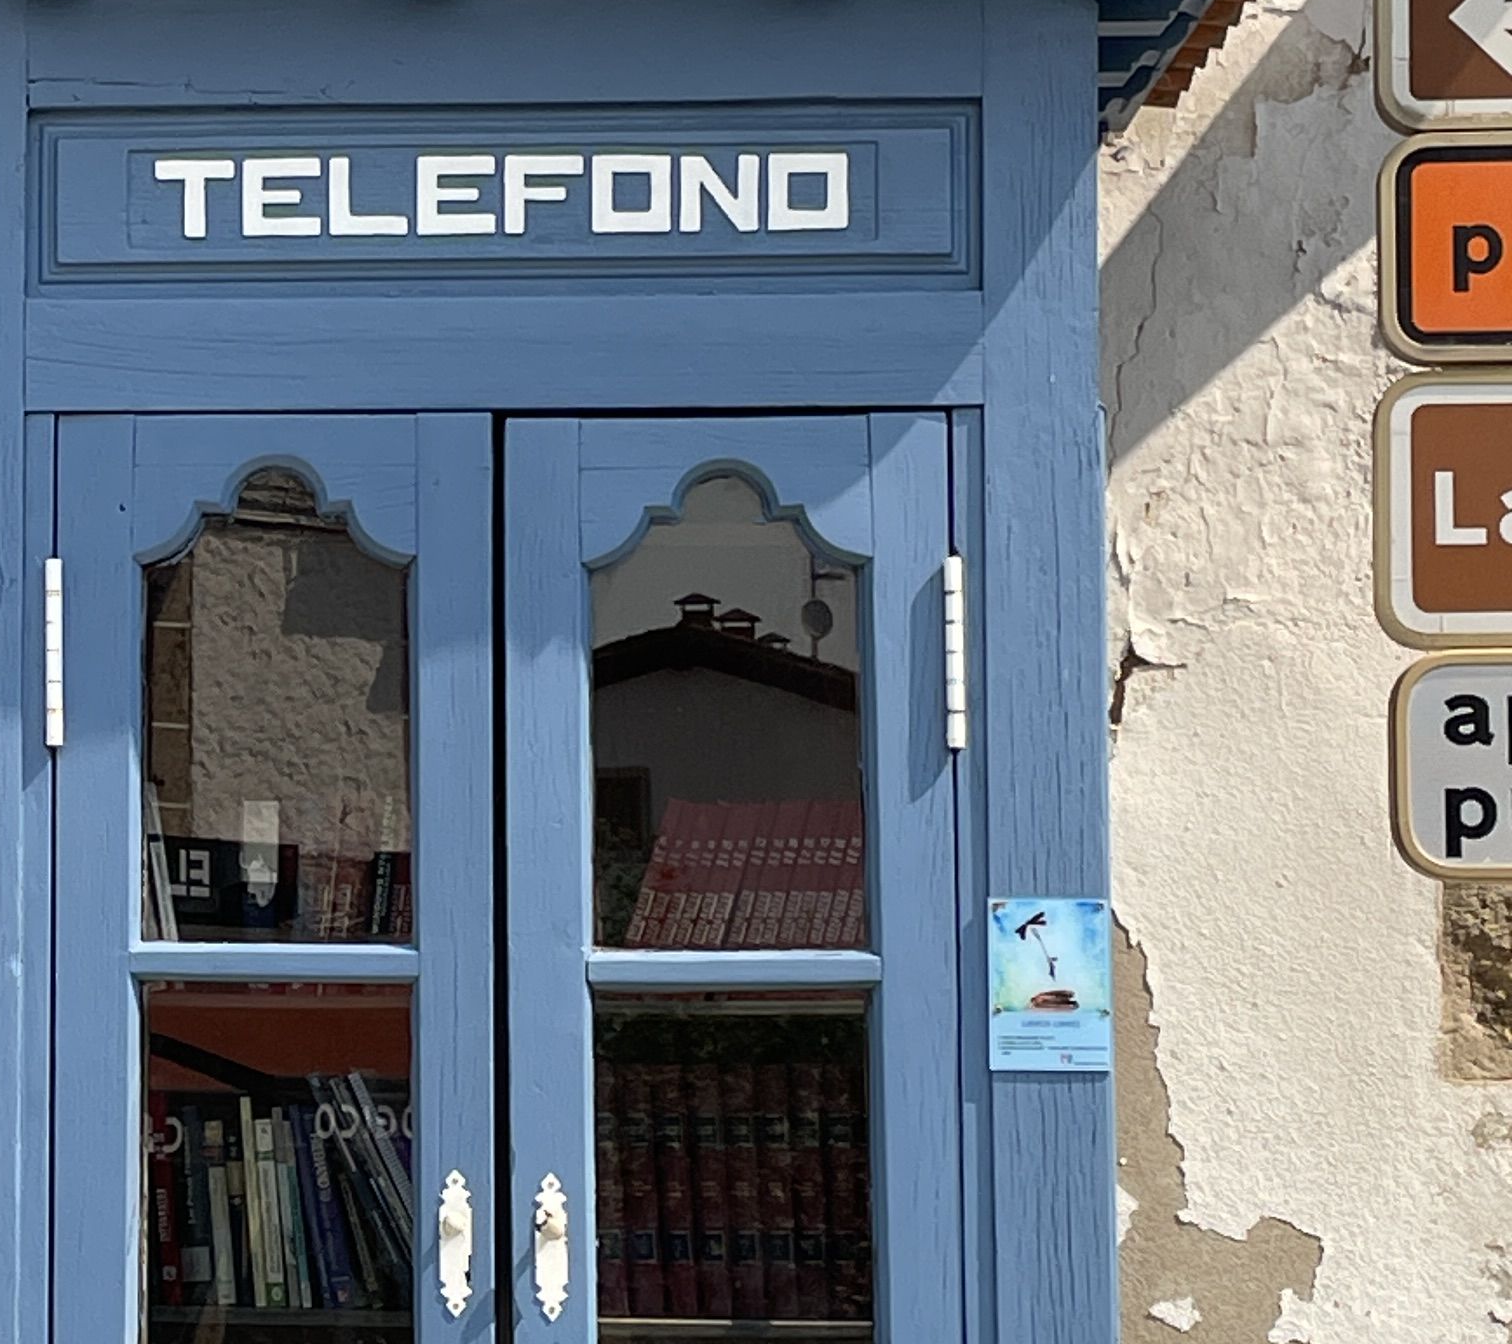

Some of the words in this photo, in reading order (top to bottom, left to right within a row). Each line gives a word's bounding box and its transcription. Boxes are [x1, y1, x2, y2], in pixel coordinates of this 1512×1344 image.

[154, 152, 849, 238] TELEFONO
[1433, 470, 1512, 546] L
[1443, 694, 1512, 765] a
